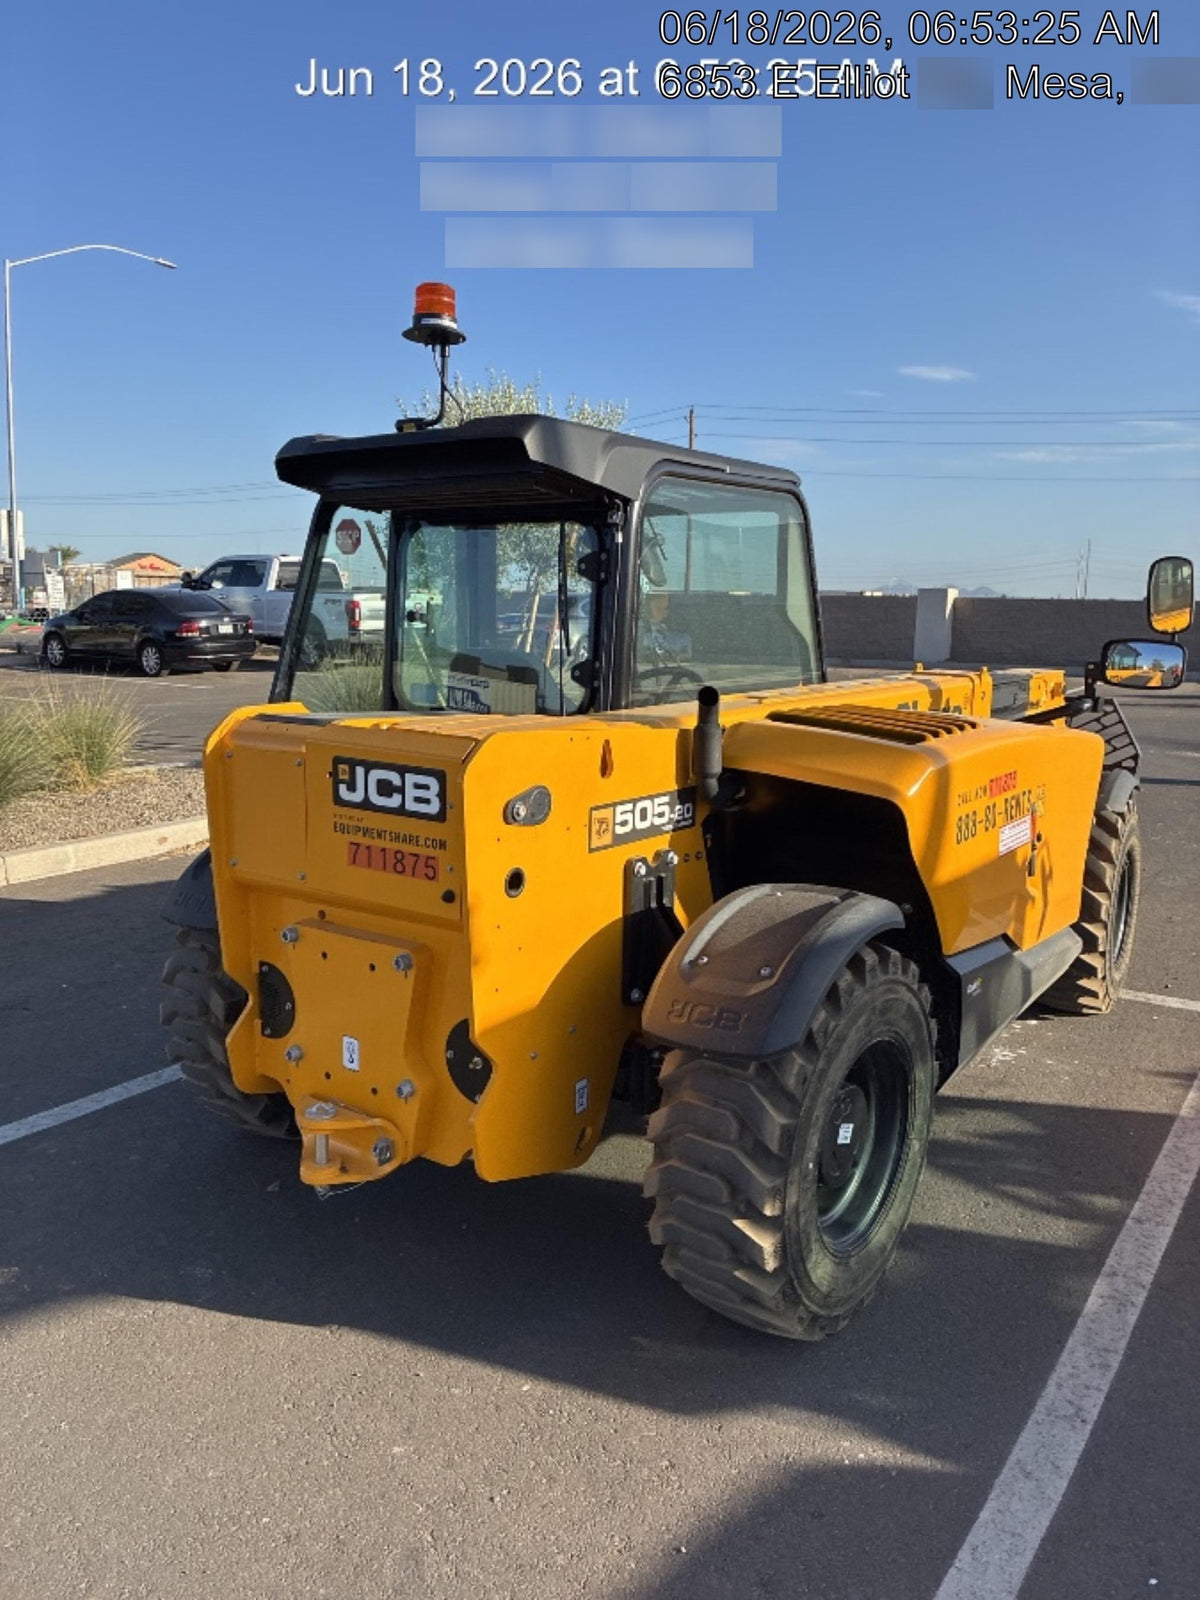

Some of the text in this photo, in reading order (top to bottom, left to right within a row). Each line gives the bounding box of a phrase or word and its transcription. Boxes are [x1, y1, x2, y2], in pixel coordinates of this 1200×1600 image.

[338, 765, 440, 815] JCB
[333, 821, 447, 851] EQUIPMENTSHARE.COM
[350, 842, 437, 881] 711875
